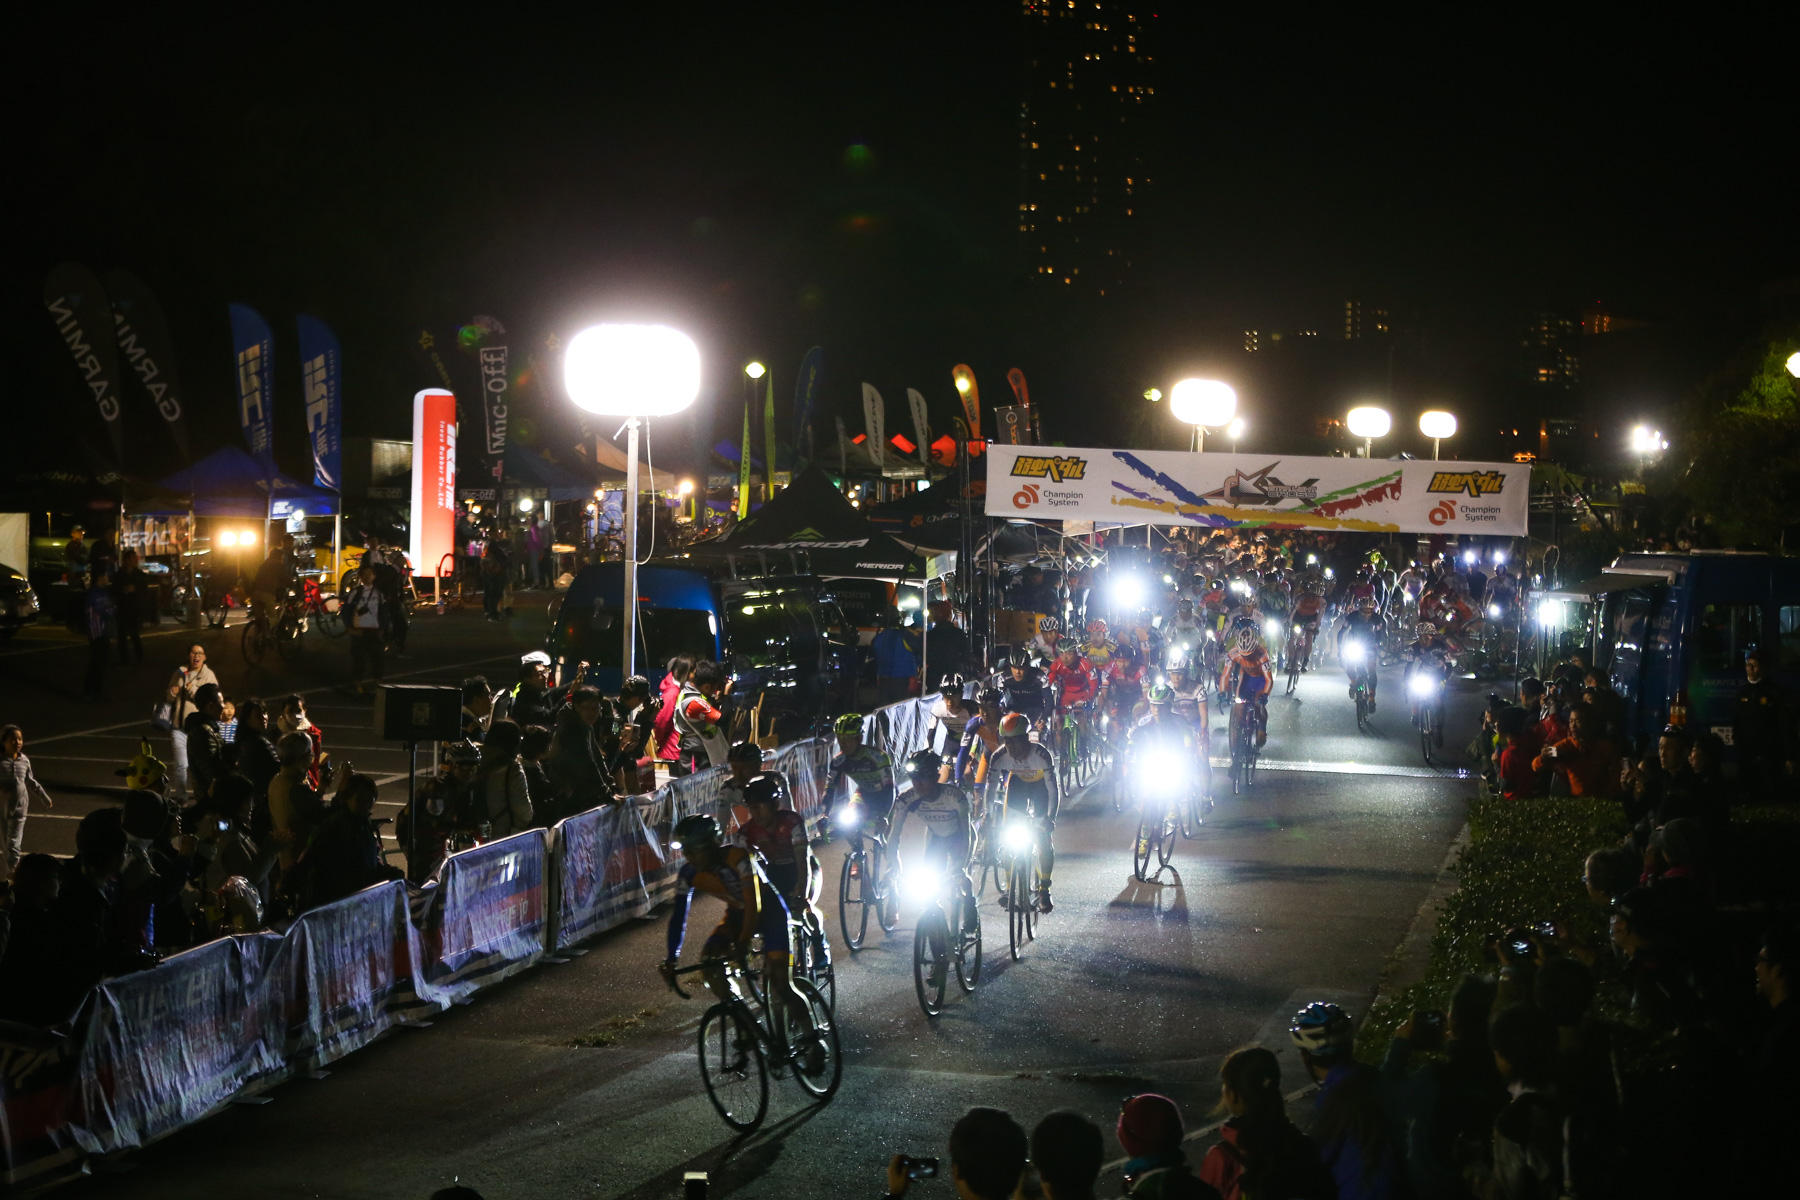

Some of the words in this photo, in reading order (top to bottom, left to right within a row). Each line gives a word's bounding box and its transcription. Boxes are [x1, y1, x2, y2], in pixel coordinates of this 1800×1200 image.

[1043, 490, 1084, 500] Champion
[1048, 499, 1079, 507] System
[1460, 505, 1501, 515] Champion
[1465, 514, 1497, 523] System
[739, 538, 870, 549] MERIDA
